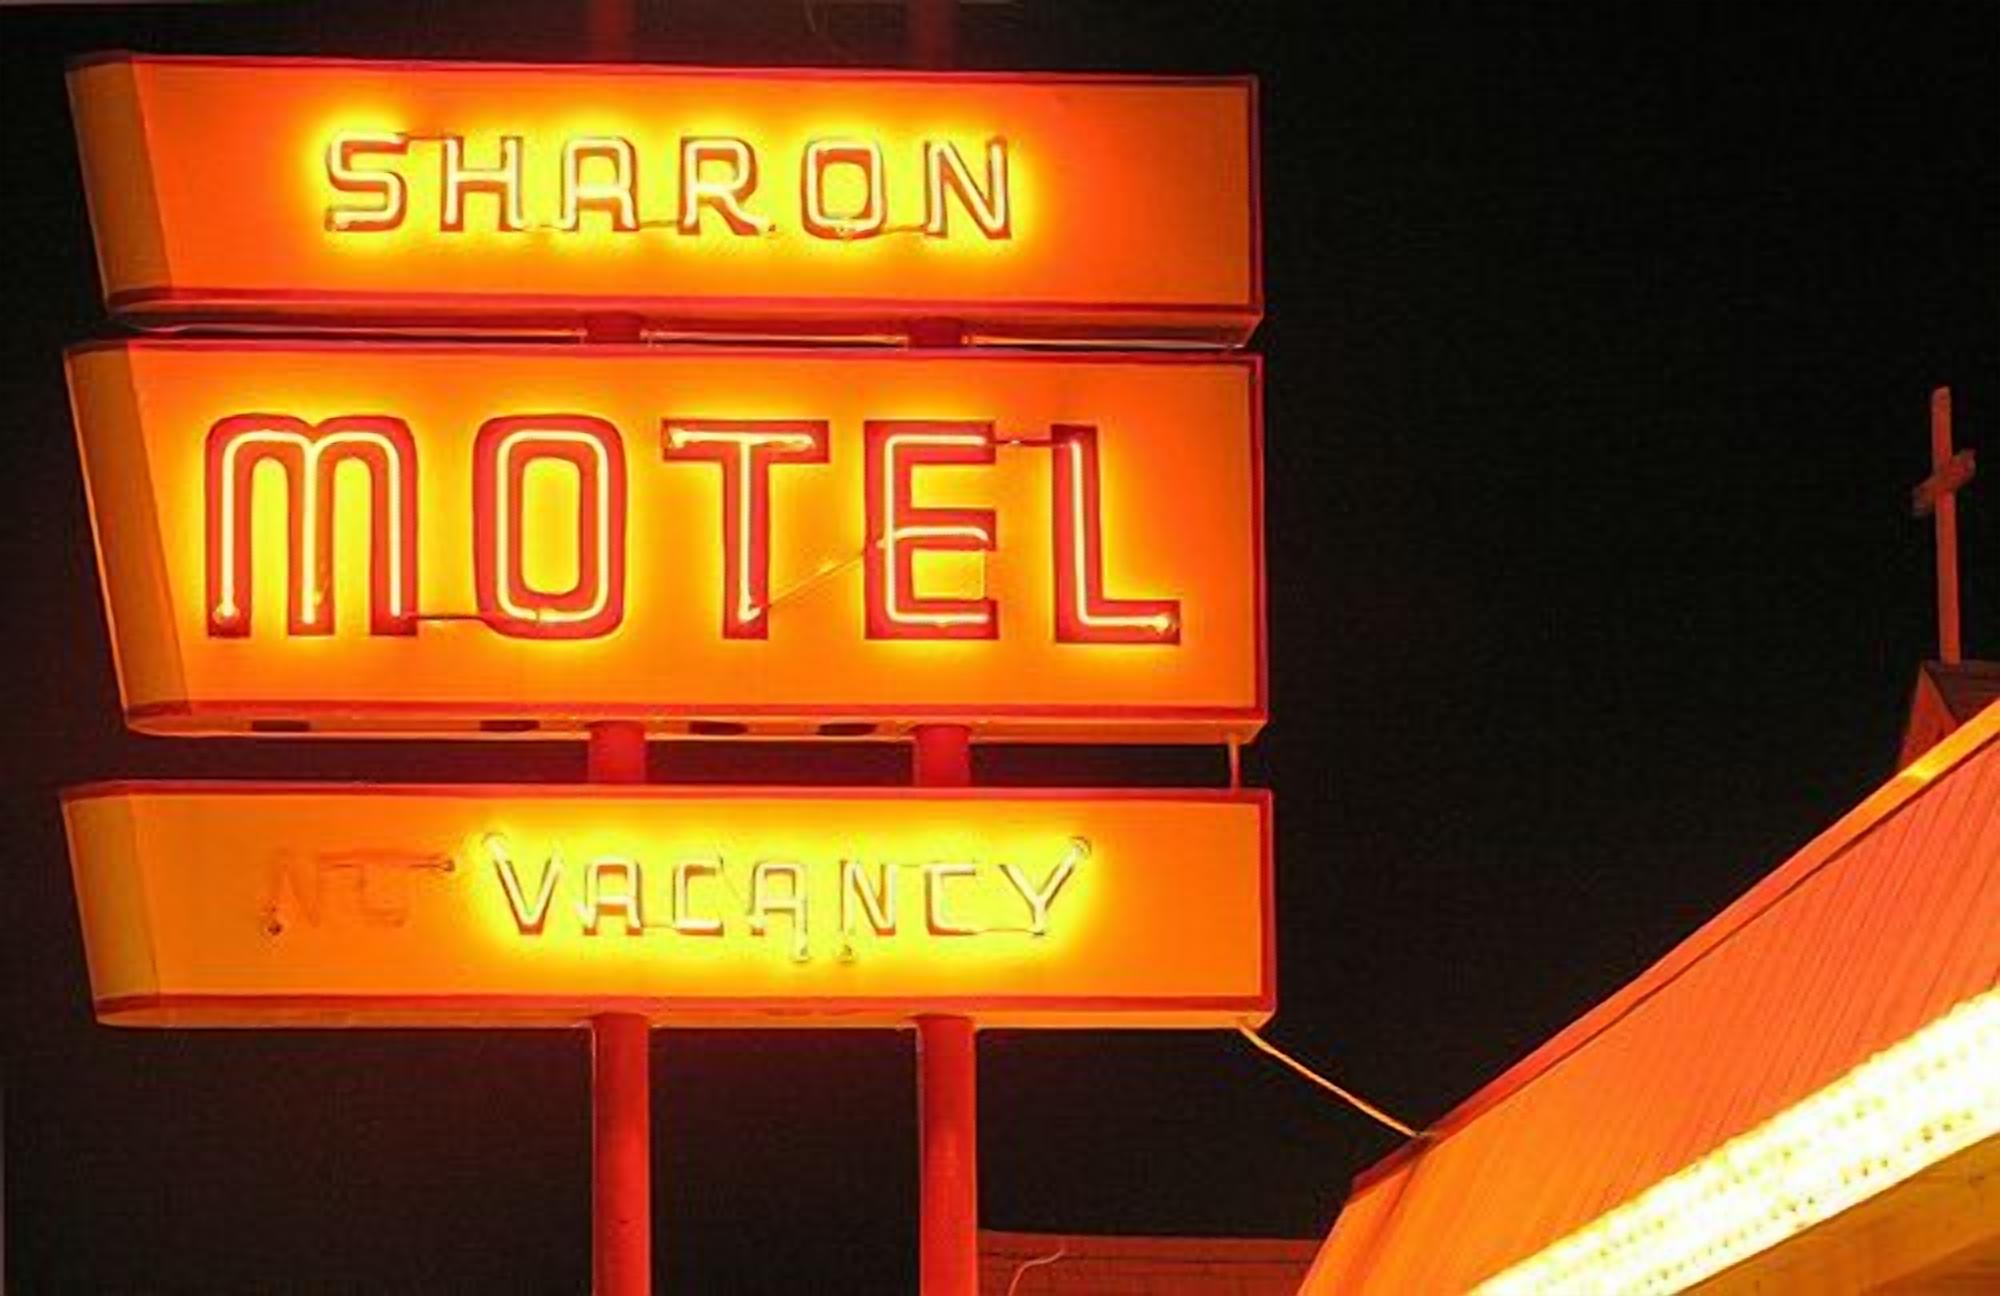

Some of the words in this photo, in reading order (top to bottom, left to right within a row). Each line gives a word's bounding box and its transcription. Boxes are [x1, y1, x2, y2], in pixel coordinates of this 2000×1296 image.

[325, 132, 1012, 240] SHARON
[205, 413, 1181, 645] MOTEL
[486, 835, 1090, 940] VACANCY
